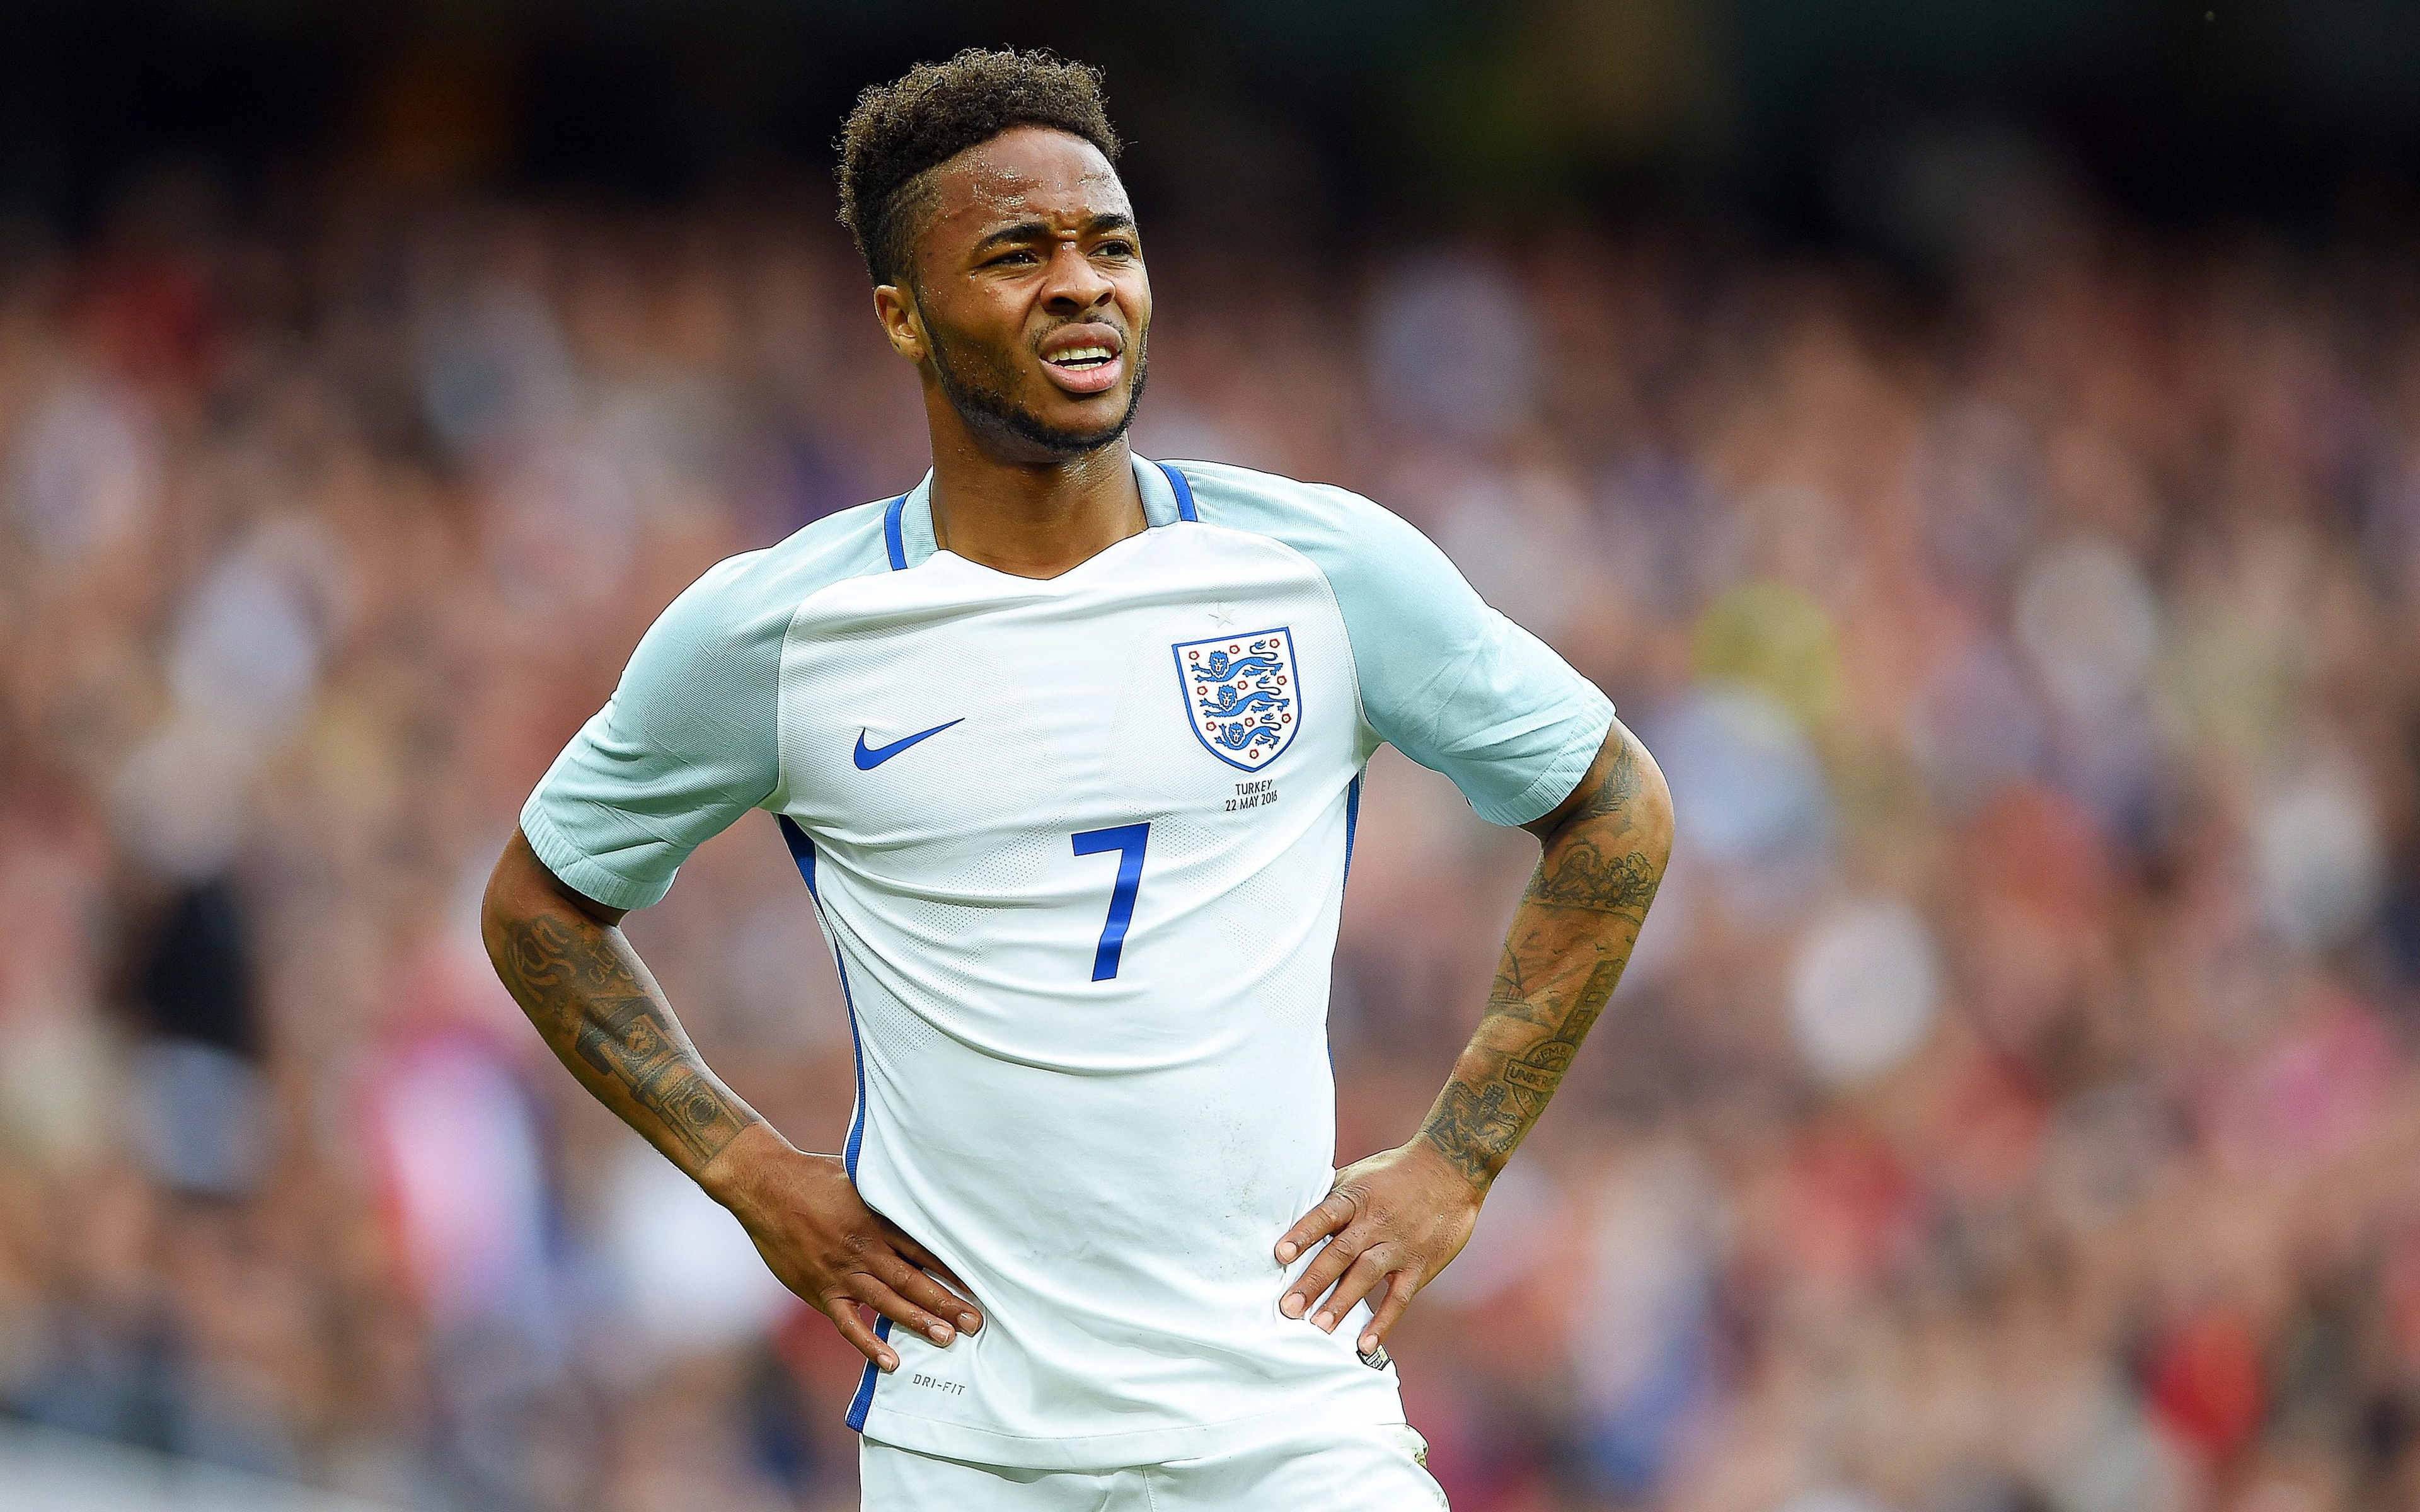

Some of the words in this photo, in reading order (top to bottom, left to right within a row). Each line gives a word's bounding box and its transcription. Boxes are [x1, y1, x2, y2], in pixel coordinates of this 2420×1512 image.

[1235, 779, 1273, 796] TURKEY
[1225, 799, 1236, 811] 22
[1240, 795, 1259, 810] MAY
[1261, 789, 1277, 806] 2016
[1071, 822, 1151, 982] 7
[913, 1373, 965, 1395] DRI-FIT
